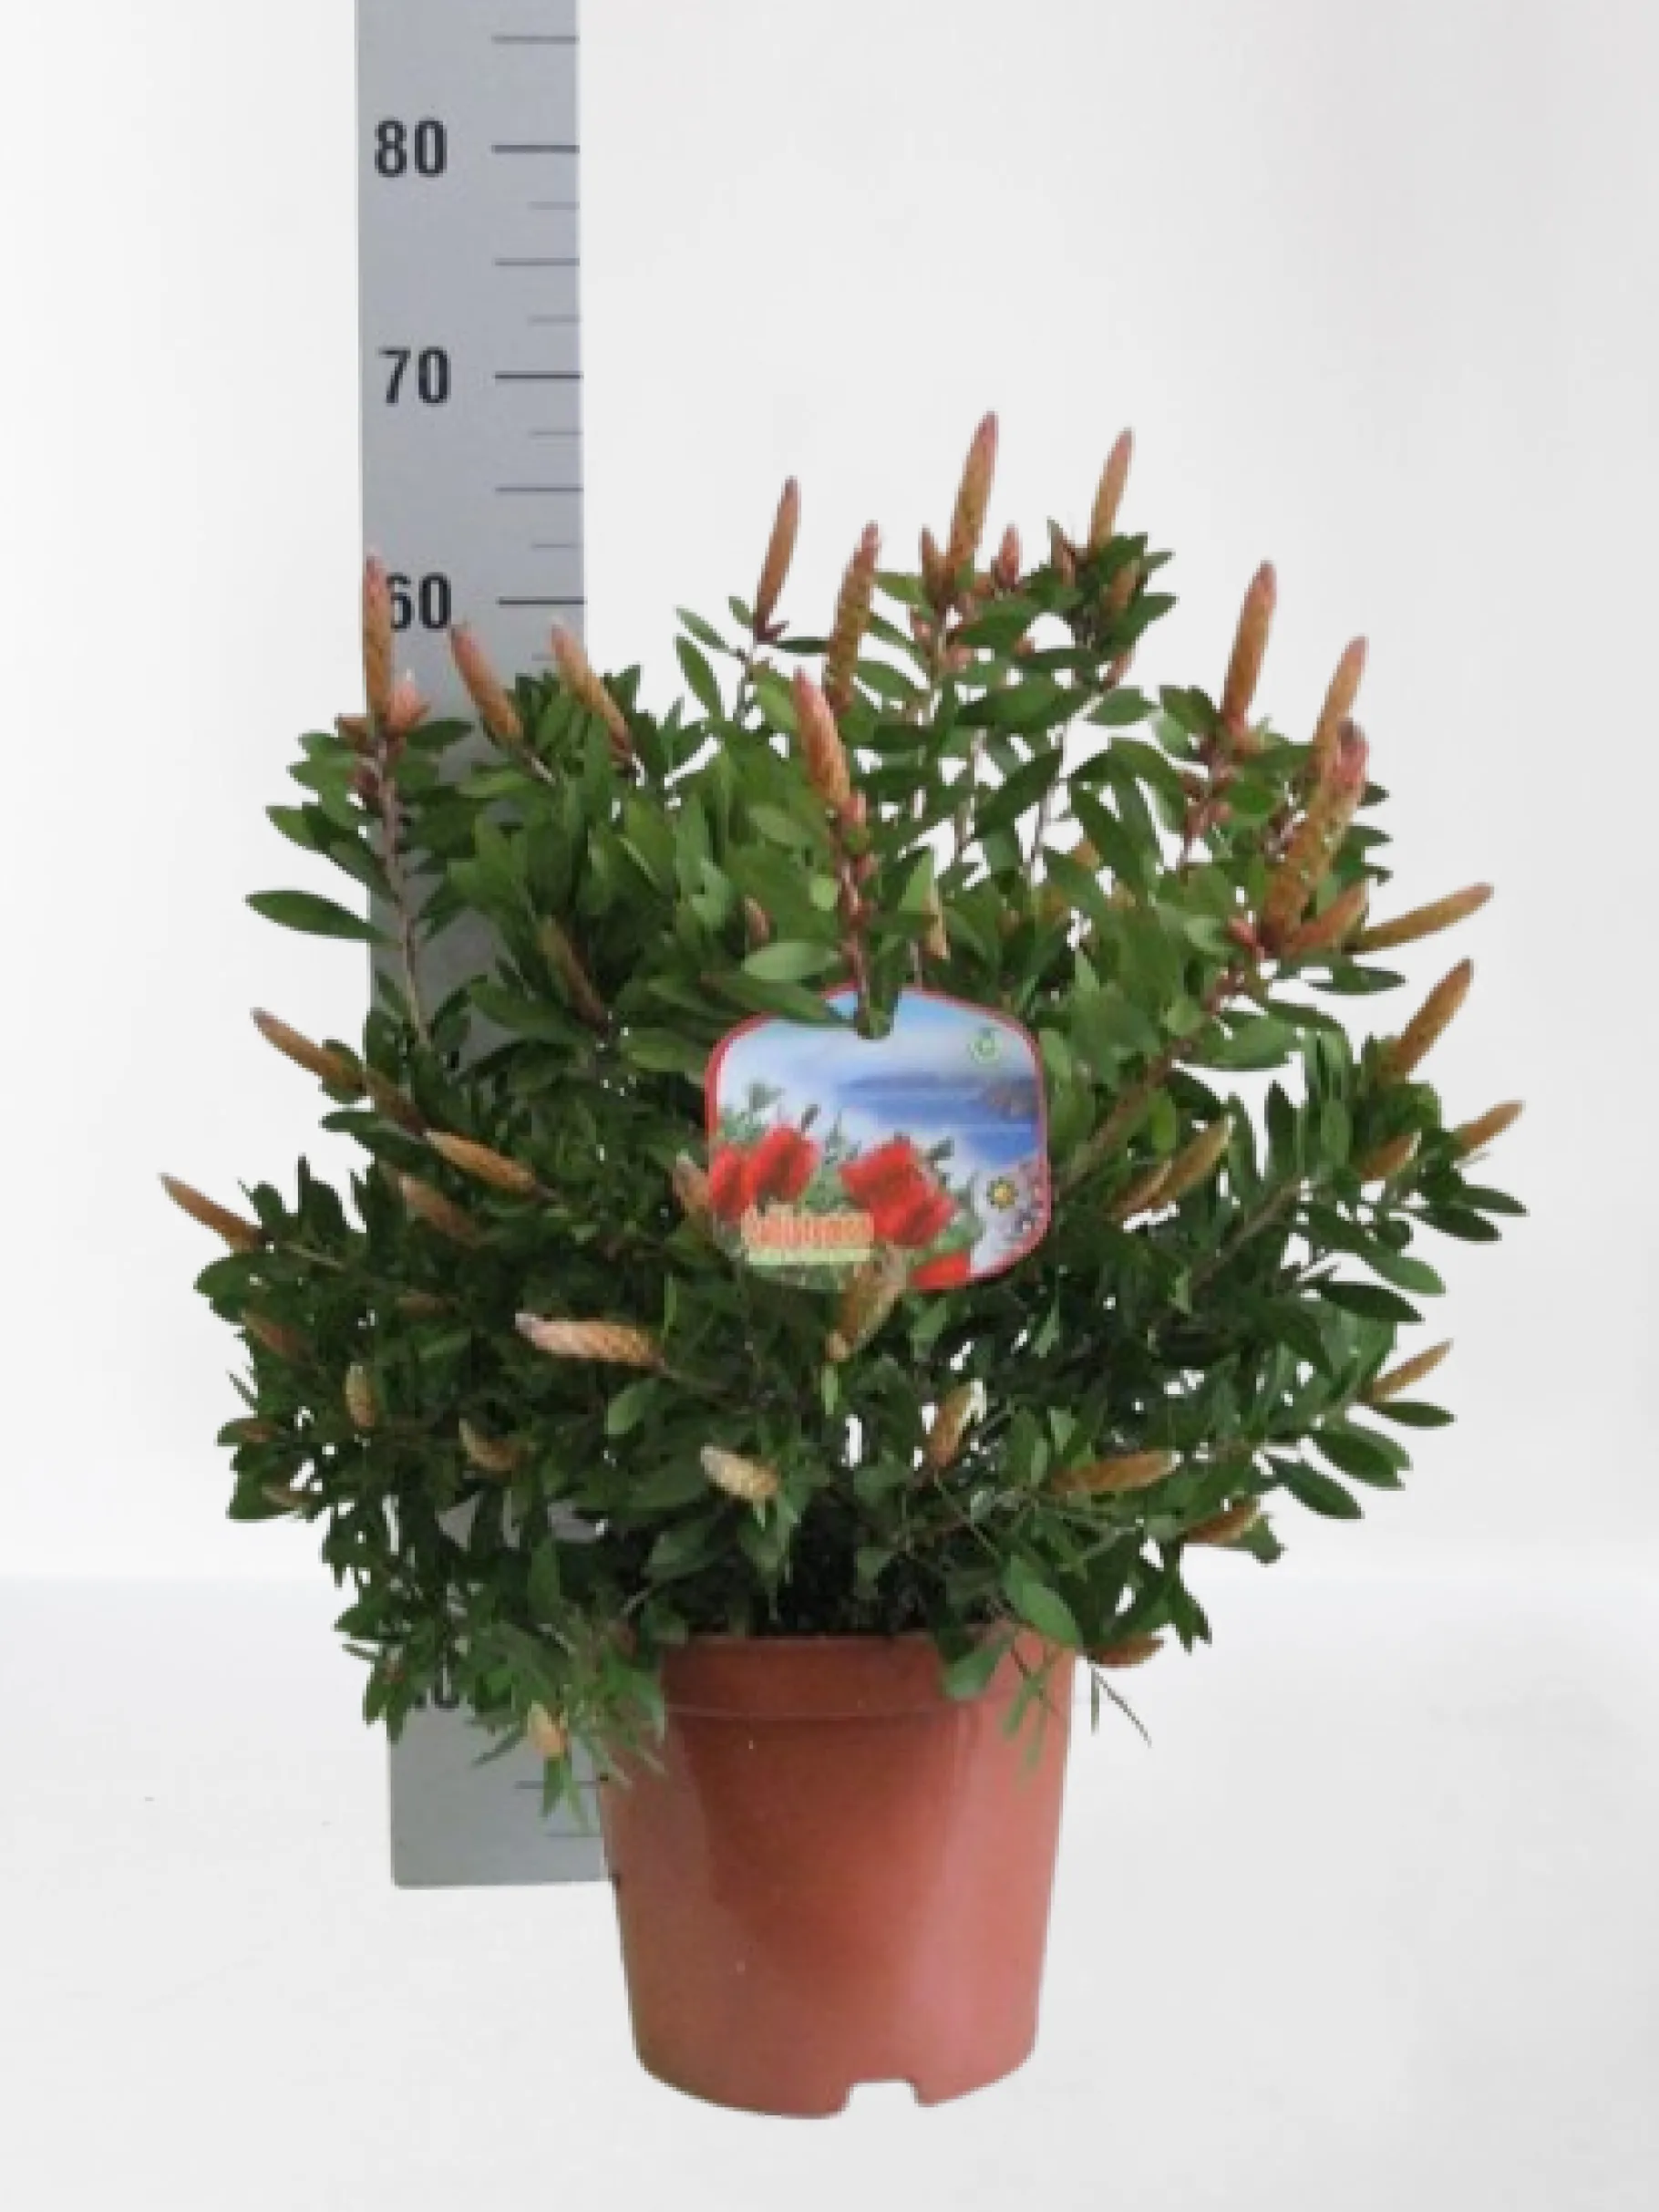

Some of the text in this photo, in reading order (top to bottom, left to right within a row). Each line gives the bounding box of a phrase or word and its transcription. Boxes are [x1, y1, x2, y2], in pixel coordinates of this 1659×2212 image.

[375, 119, 447, 178] 80
[378, 346, 451, 406] 70
[386, 572, 451, 632] 60
